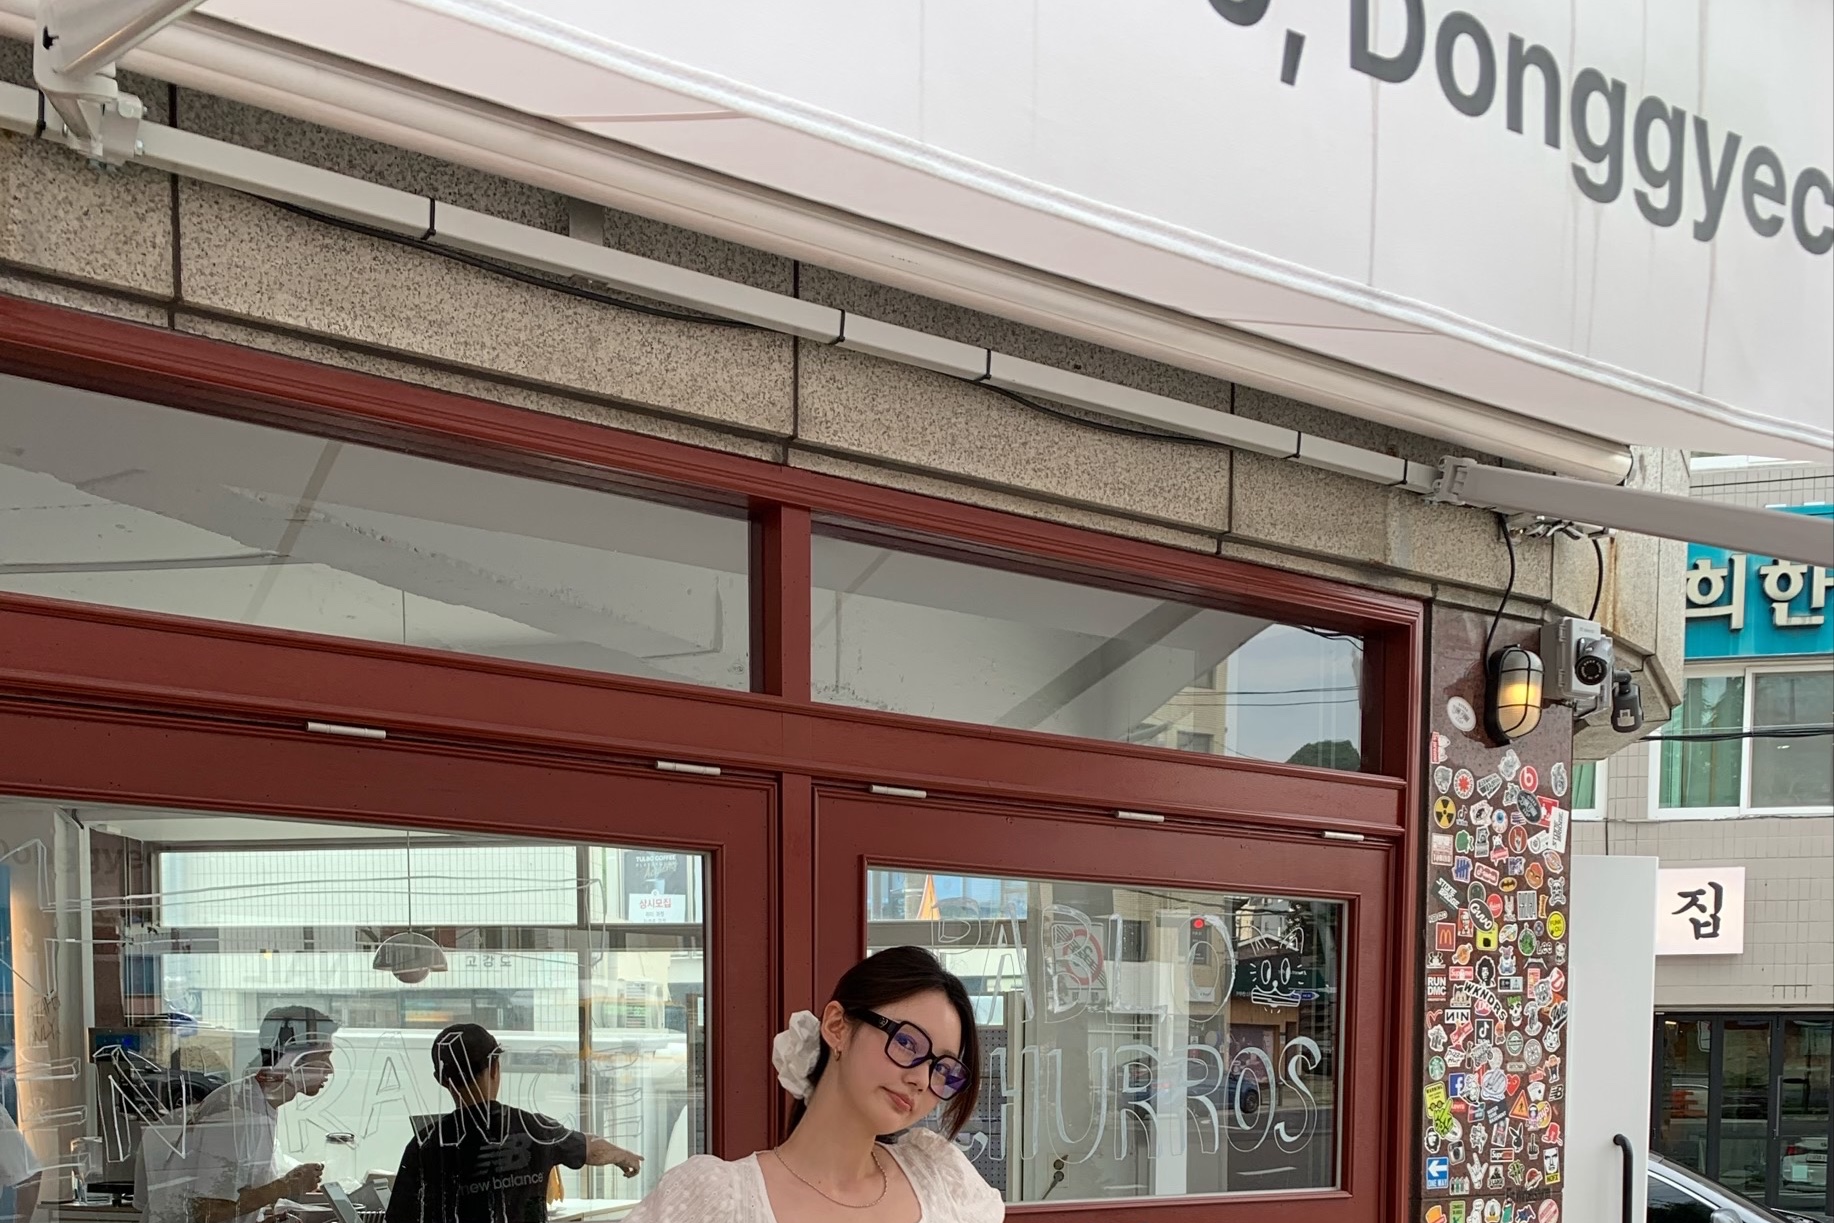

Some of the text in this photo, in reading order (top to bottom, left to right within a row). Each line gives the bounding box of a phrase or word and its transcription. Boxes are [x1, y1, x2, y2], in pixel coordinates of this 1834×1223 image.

[640, 899, 672, 909] 상시모집
[1672, 881, 1723, 940] 집
[931, 896, 1238, 1024] PABLO
[1427, 977, 1447, 986] RUN
[1427, 986, 1447, 996] DMC
[1463, 981, 1507, 1021] WKNDRS
[459, 1170, 545, 1196] new balance
